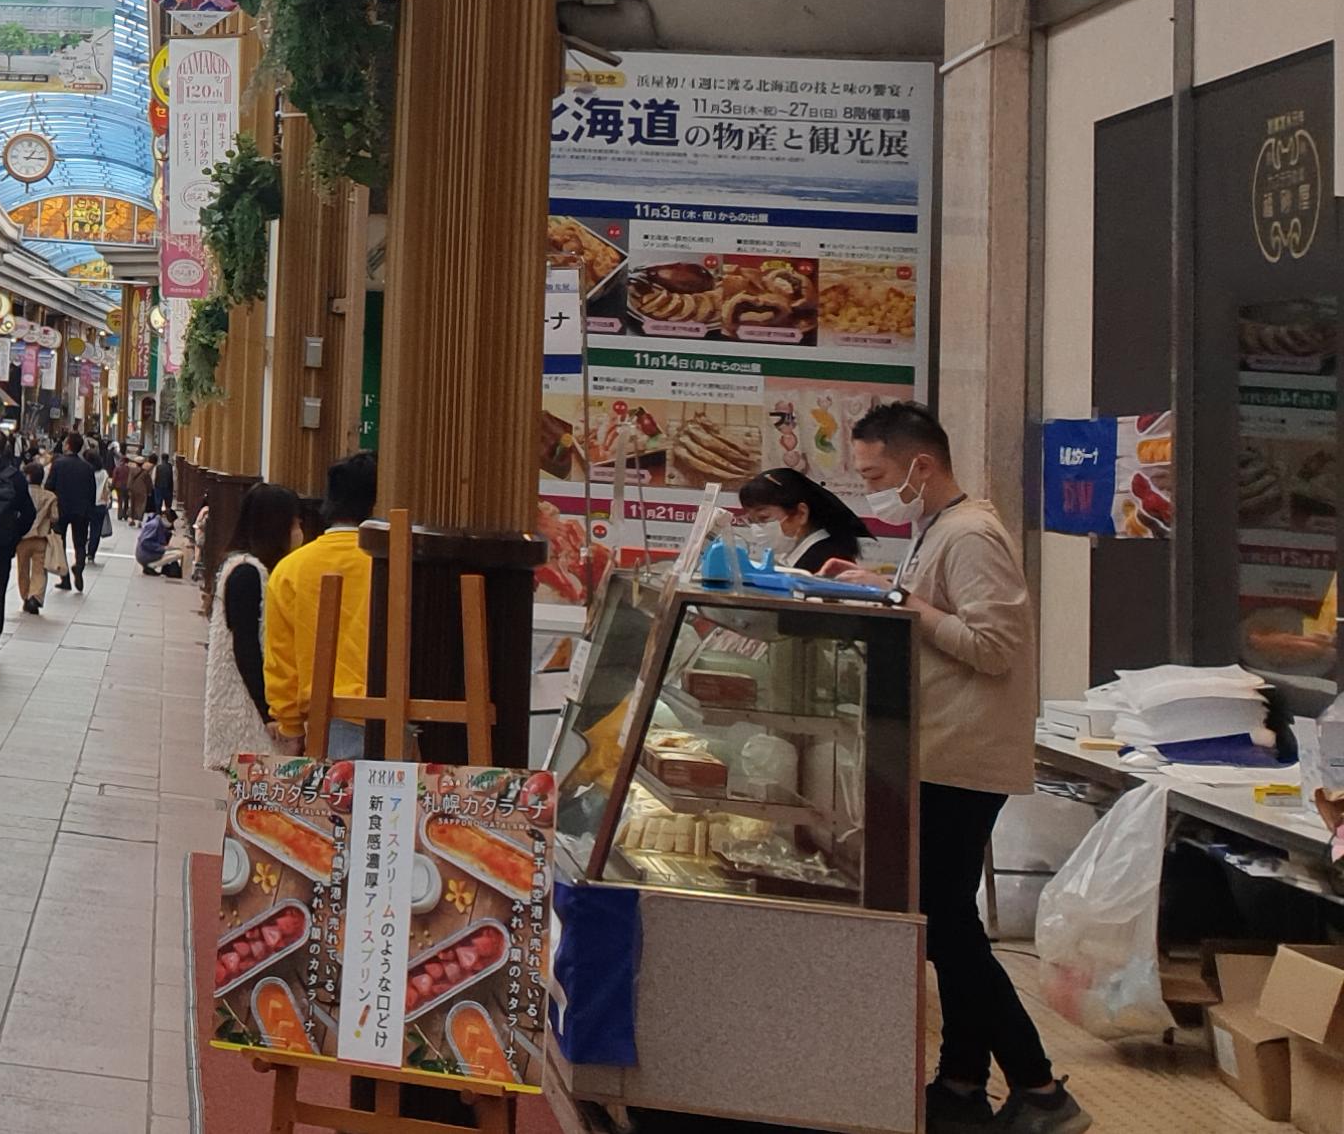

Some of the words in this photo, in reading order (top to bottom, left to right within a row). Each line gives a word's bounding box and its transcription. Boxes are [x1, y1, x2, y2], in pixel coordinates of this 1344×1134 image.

[185, 84, 223, 98] 120th
[685, 122, 910, 158] の物産と観光展
[232, 780, 349, 807] 札幌カタラーナ
[422, 791, 547, 819] 札幌カタラーナ
[374, 795, 403, 1049] アイスクリームのような口どけ
